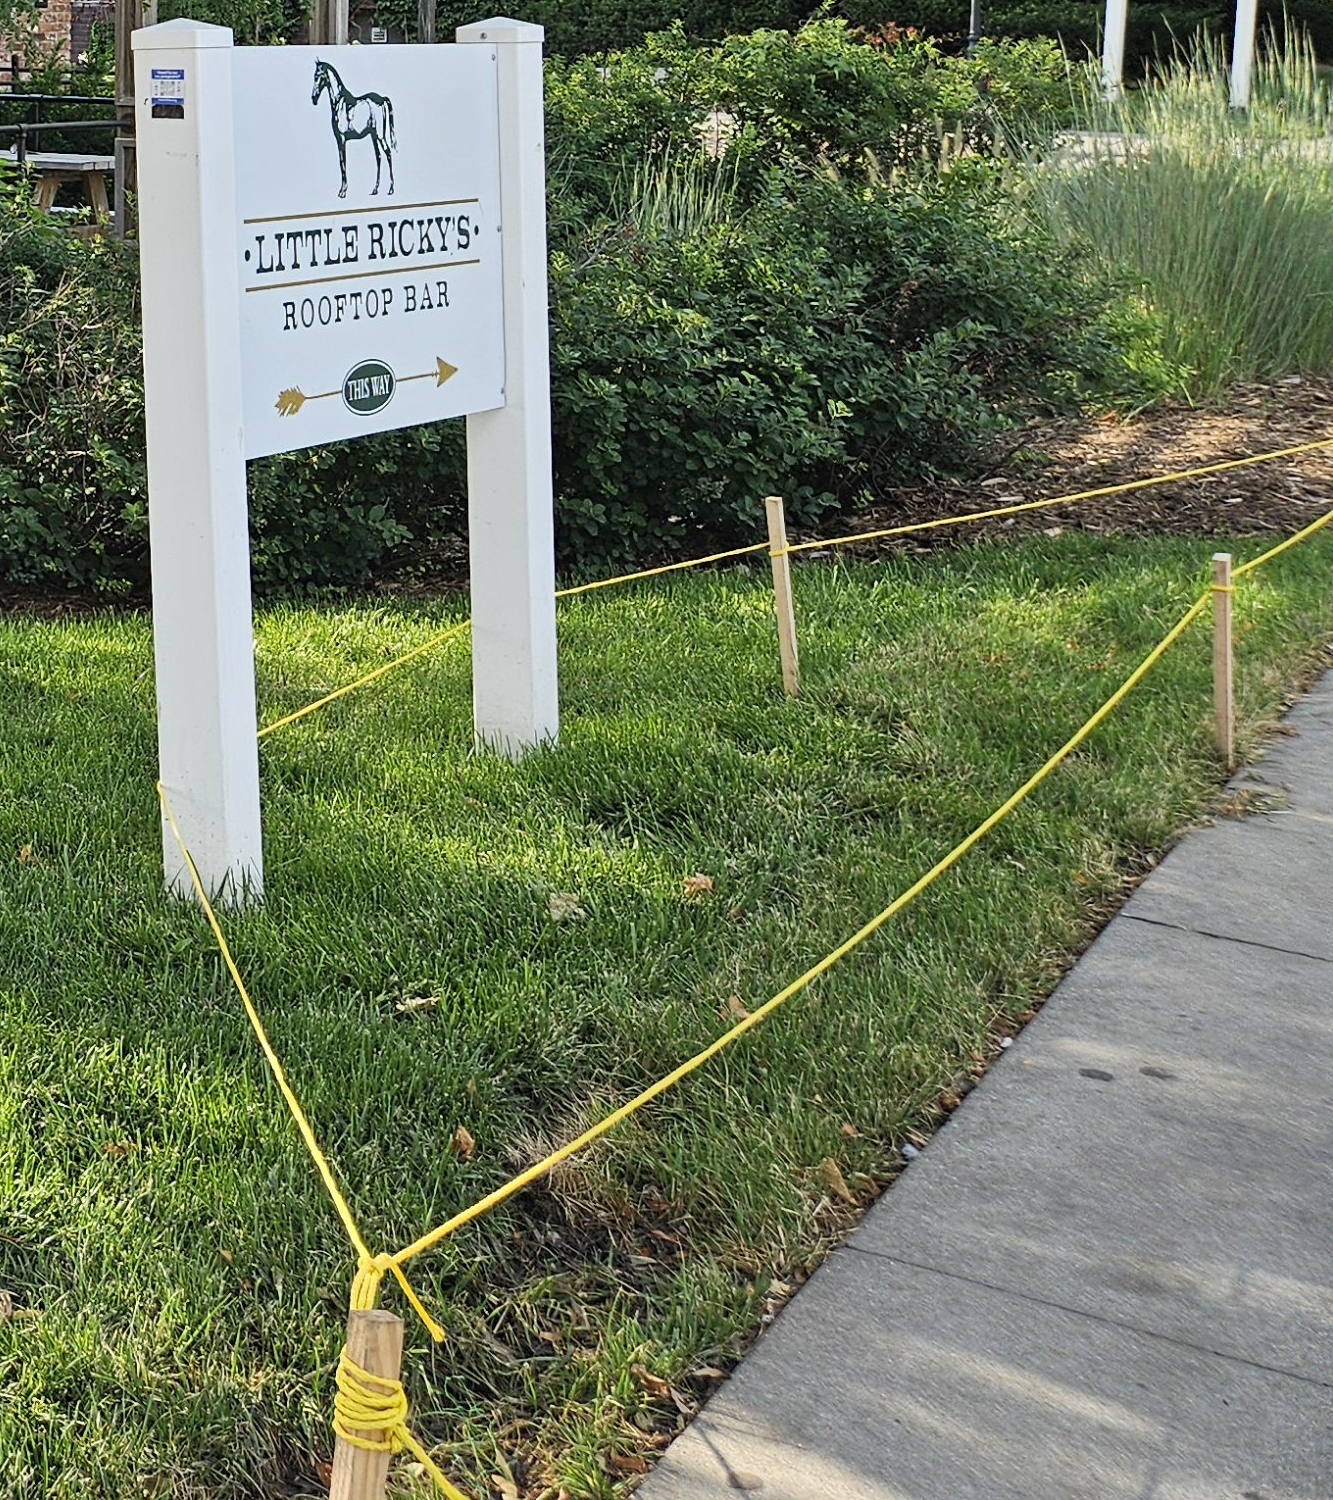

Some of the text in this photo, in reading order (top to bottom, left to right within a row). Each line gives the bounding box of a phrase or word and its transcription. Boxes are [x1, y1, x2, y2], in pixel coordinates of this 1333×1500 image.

[255, 215, 471, 274] LITTLE RICKY'S
[283, 281, 450, 331] ROOFTOP BAR
[347, 373, 392, 401] THIS WAY
